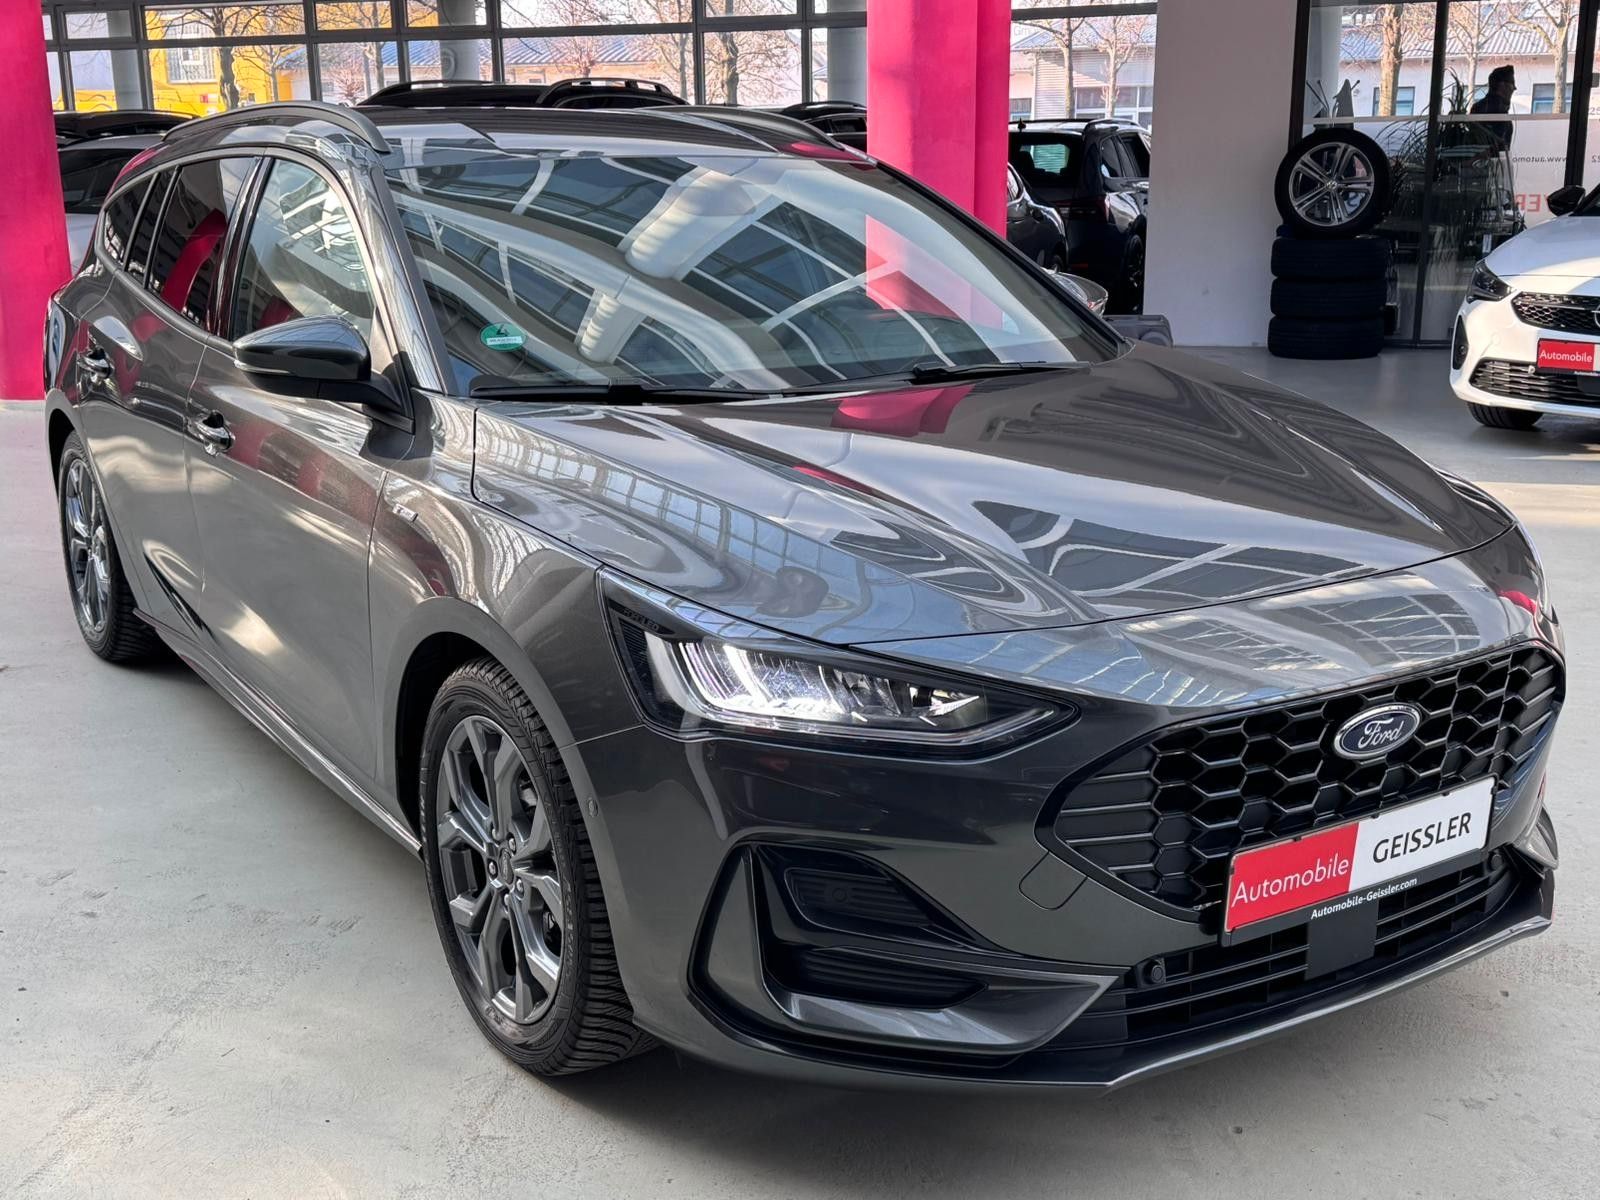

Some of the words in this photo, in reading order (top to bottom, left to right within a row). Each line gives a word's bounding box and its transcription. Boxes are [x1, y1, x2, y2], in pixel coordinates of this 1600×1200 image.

[1539, 350, 1593, 363] Automobile
[1357, 717, 1404, 749] Ford
[1231, 853, 1350, 908] Automobile
[1372, 812, 1472, 864] GEISSLER
[1310, 877, 1418, 920] Automobile-Geissler.com
